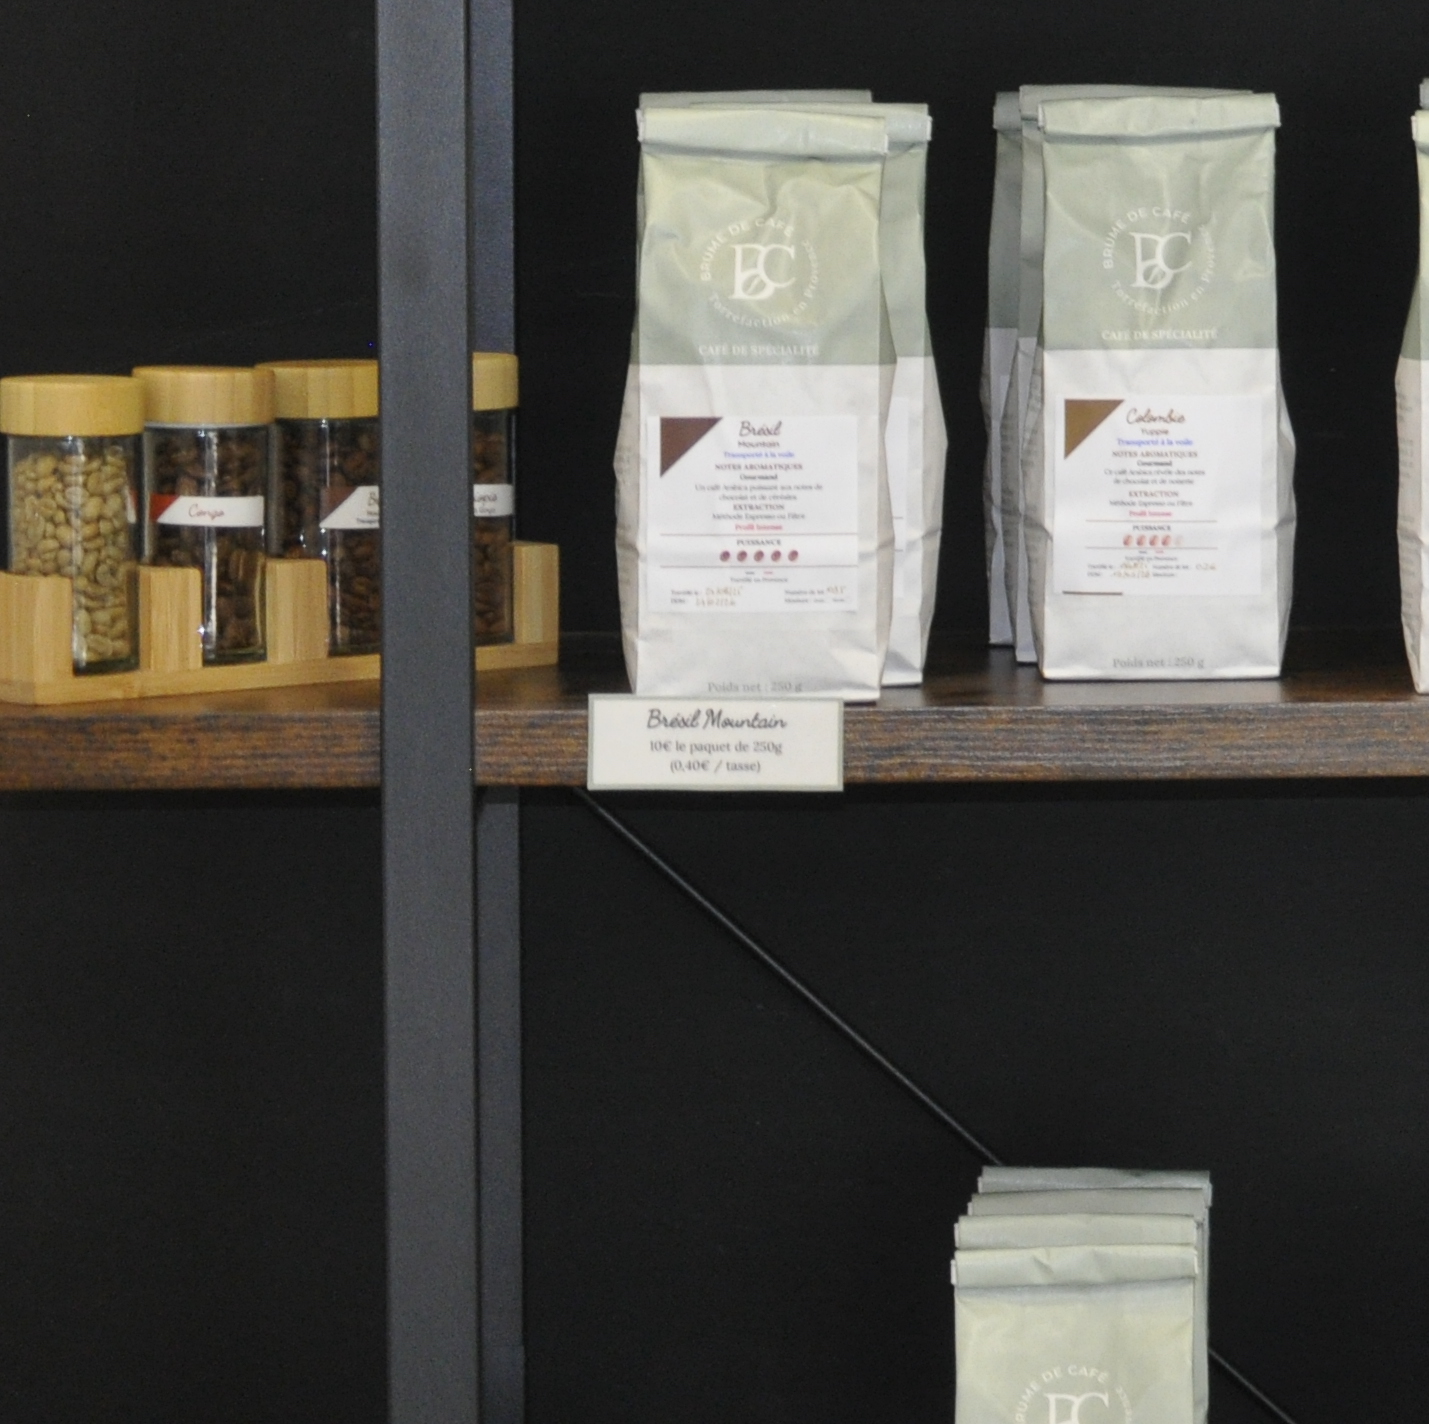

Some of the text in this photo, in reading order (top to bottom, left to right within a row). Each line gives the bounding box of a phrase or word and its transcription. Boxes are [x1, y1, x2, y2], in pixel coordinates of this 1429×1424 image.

[1126, 408, 1186, 425] Colombie
[739, 420, 783, 438] Brésil
[188, 503, 225, 521] Congo
[646, 708, 787, 730] Brésil Mountain
[649, 740, 783, 755] 10€ le paquet de 250g
[670, 760, 710, 774] (0,40€
[725, 760, 761, 774] tasse)
